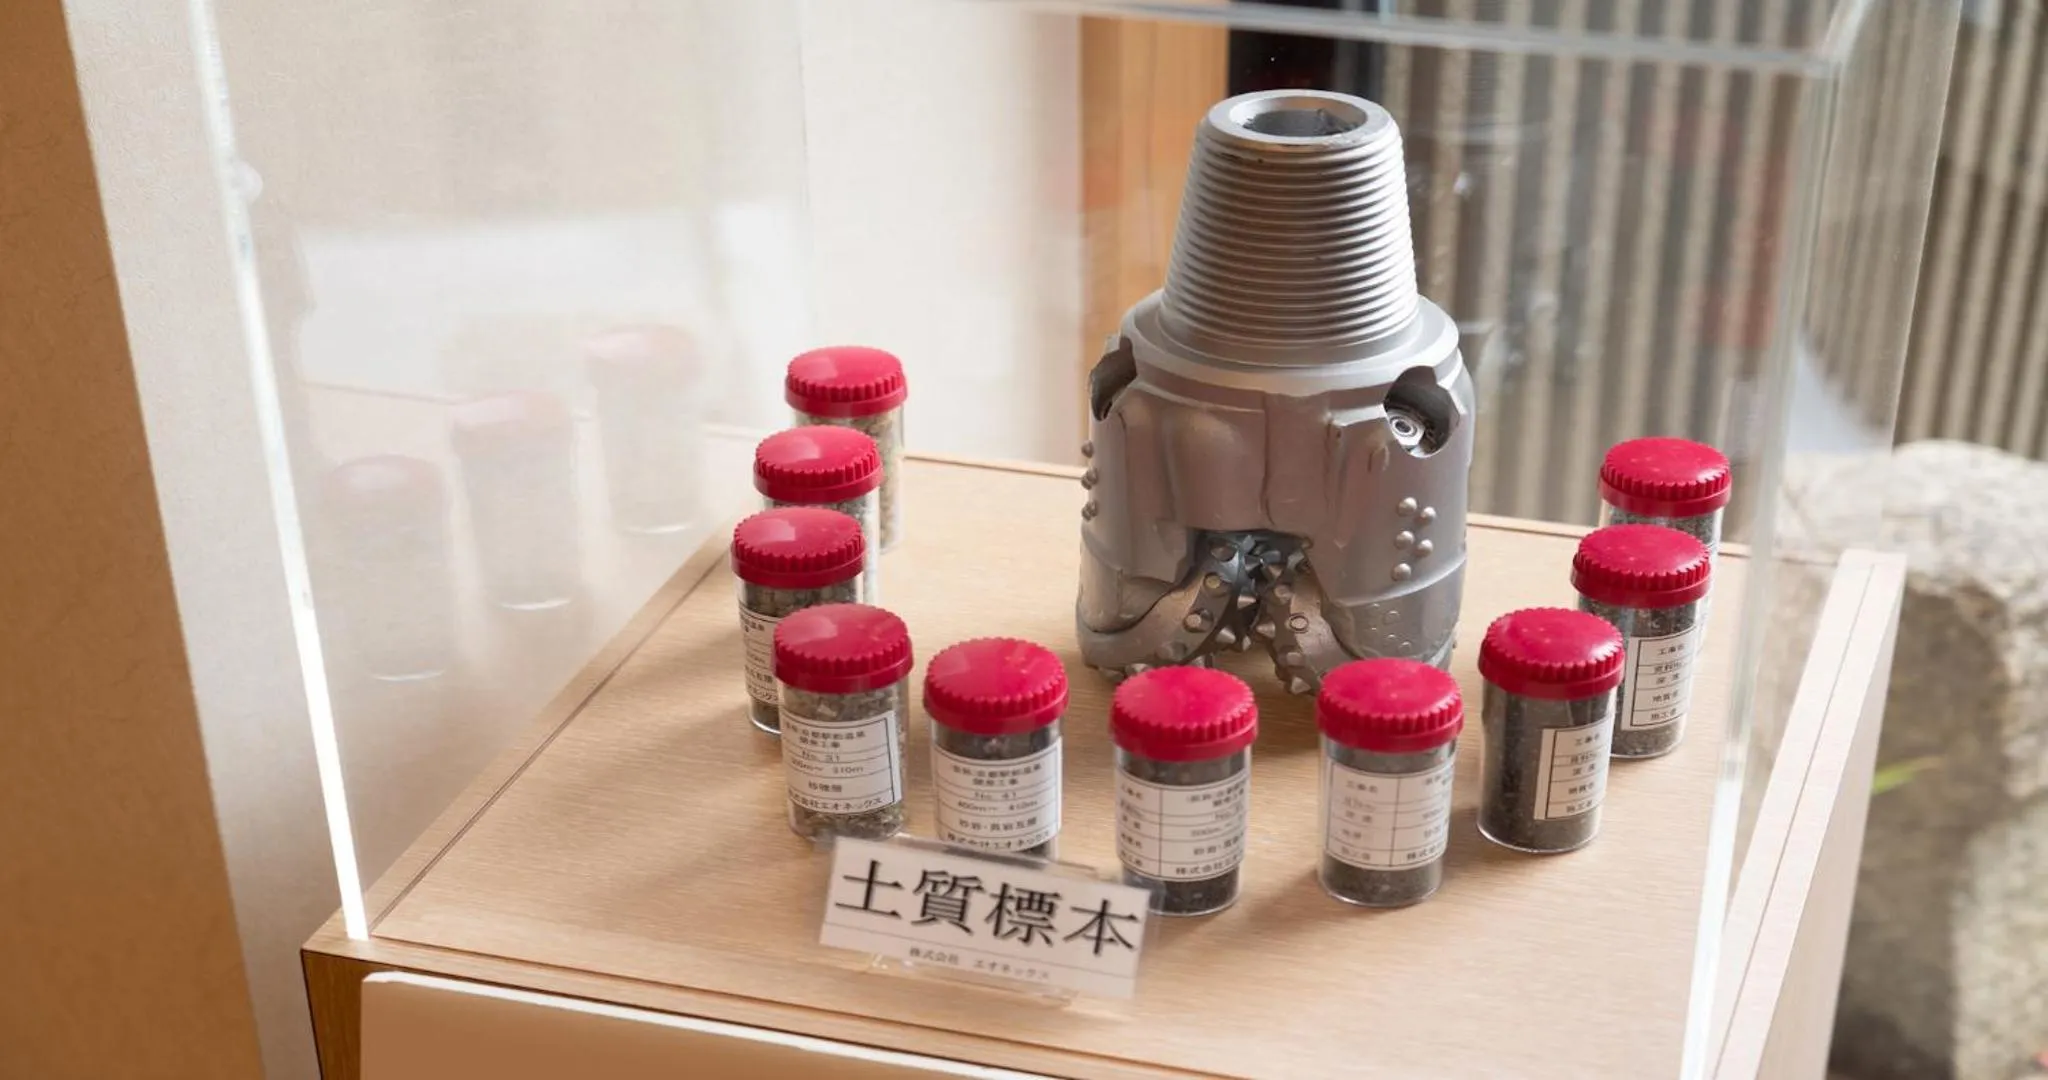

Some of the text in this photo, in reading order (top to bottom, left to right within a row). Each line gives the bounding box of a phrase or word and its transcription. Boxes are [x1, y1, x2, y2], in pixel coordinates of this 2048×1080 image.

[834, 858, 1140, 957] 土質標本
[909, 946, 959, 966] 株式会社
